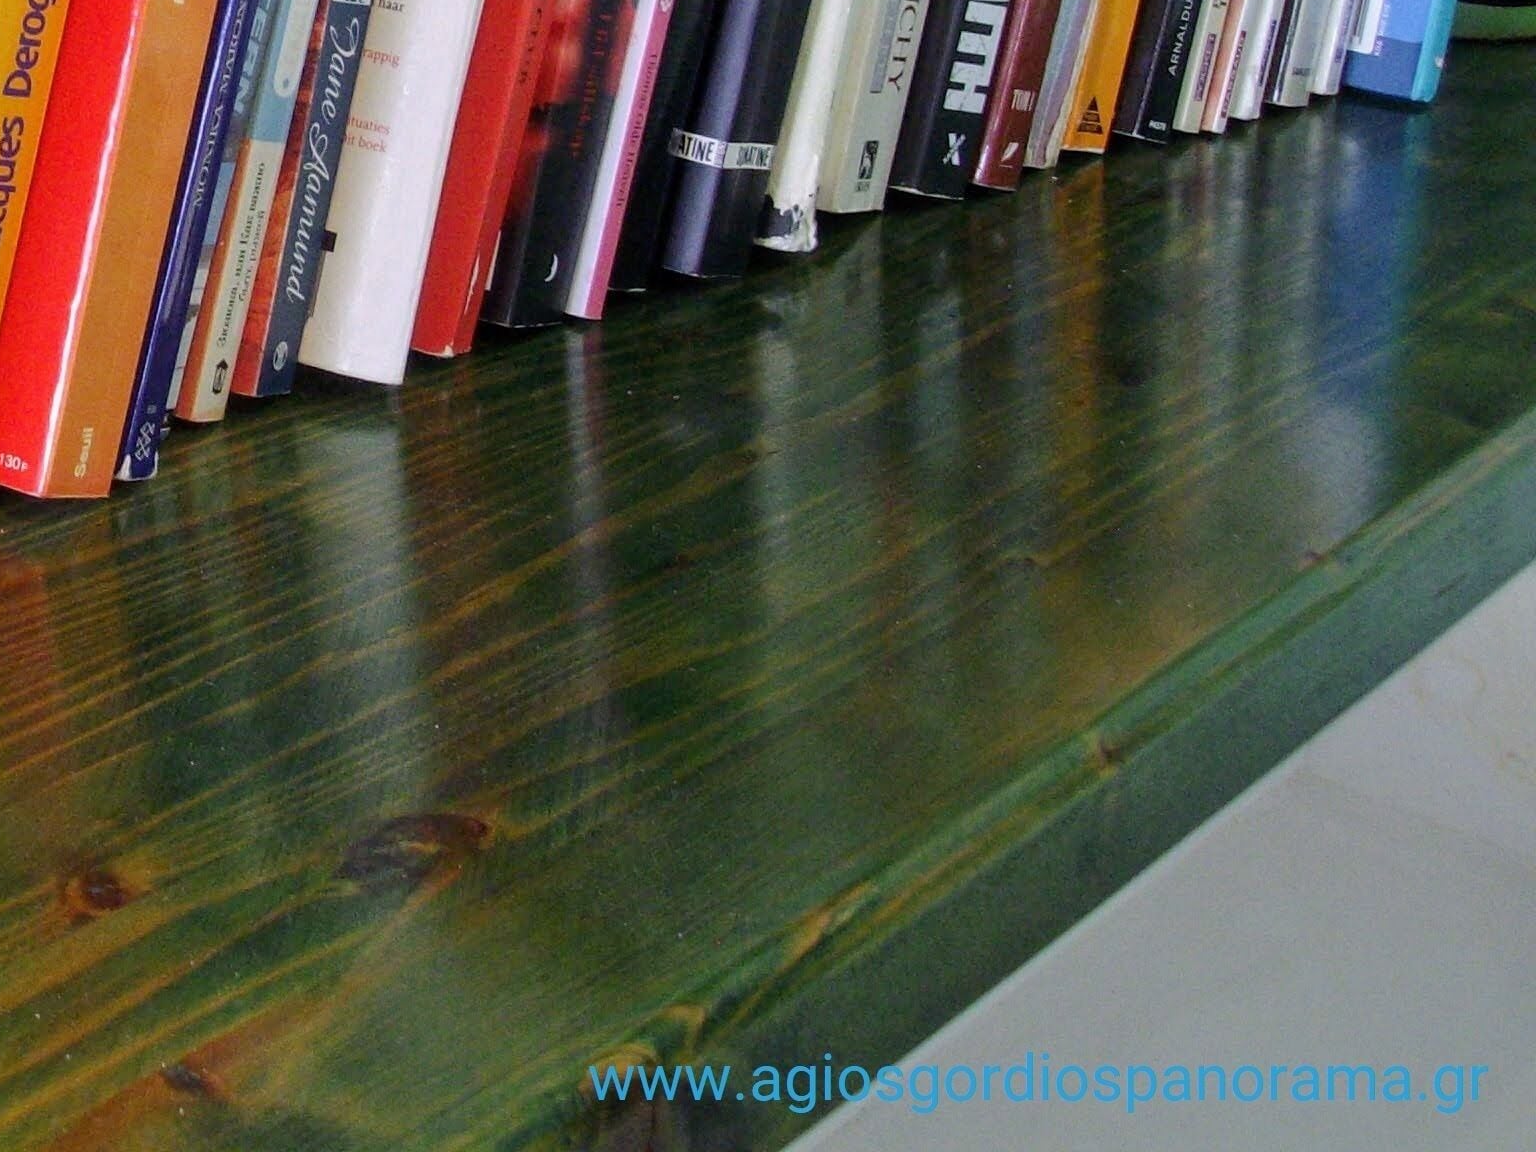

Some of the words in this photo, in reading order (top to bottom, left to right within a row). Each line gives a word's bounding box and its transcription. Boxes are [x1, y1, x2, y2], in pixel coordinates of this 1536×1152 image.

[321, 17, 360, 123] Jane
[286, 122, 330, 304] Aamund
[74, 427, 94, 478] Seuil
